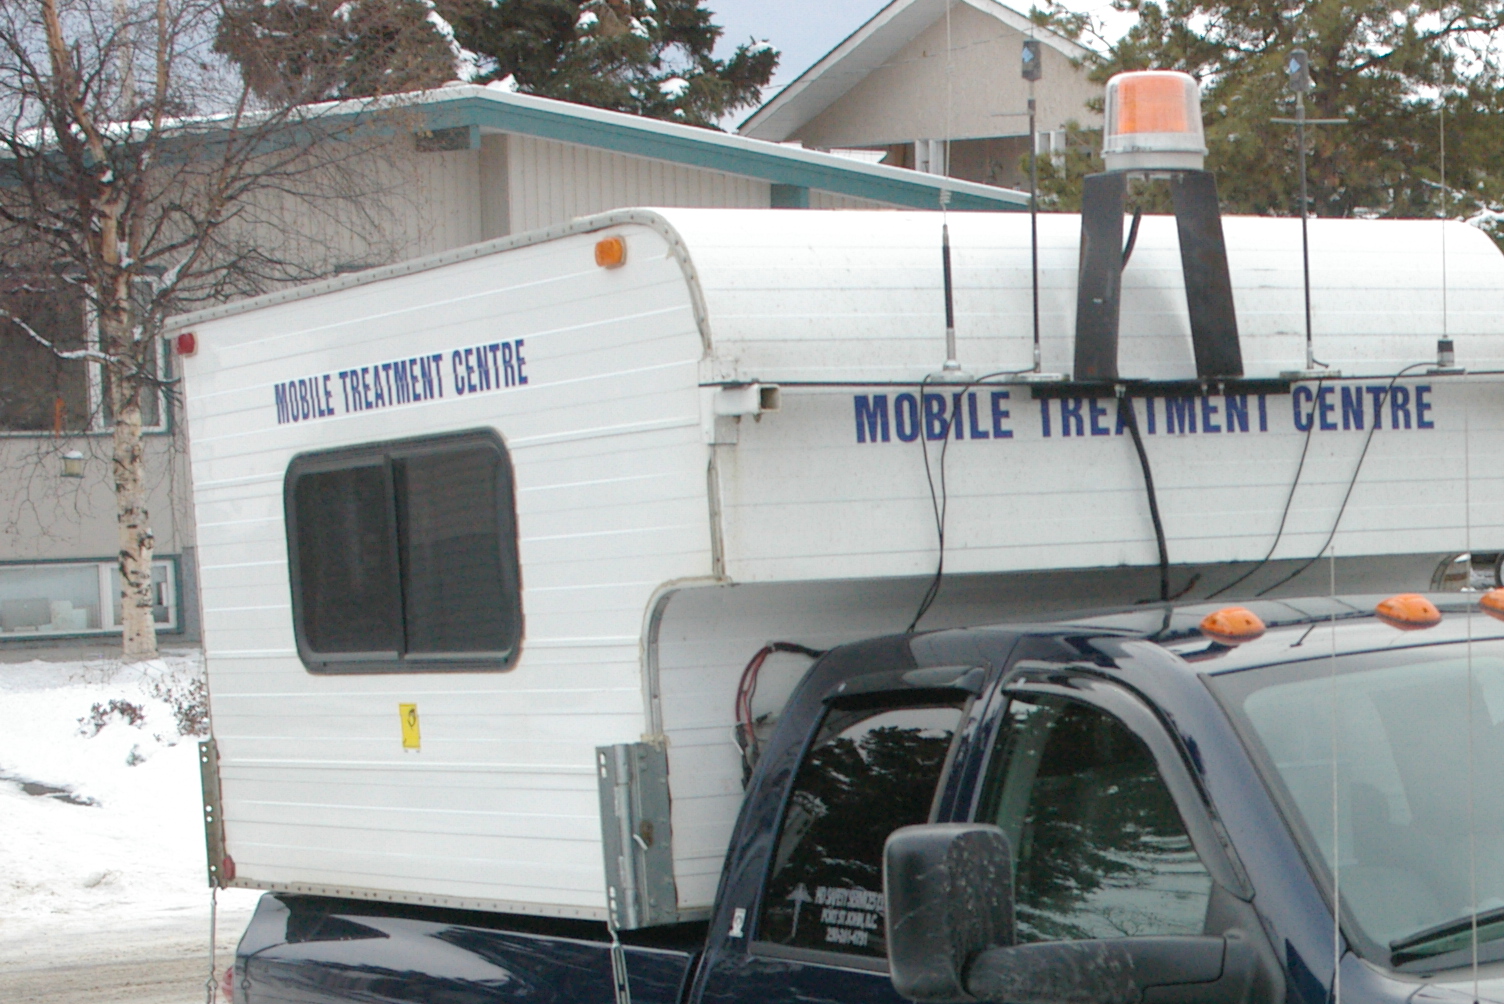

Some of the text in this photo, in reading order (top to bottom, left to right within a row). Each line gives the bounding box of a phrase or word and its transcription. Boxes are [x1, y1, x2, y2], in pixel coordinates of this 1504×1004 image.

[274, 338, 529, 424] MOBILE TREATMENT CENTRE
[854, 390, 1014, 443] MOBILE
[1293, 385, 1435, 431] CENTRE
